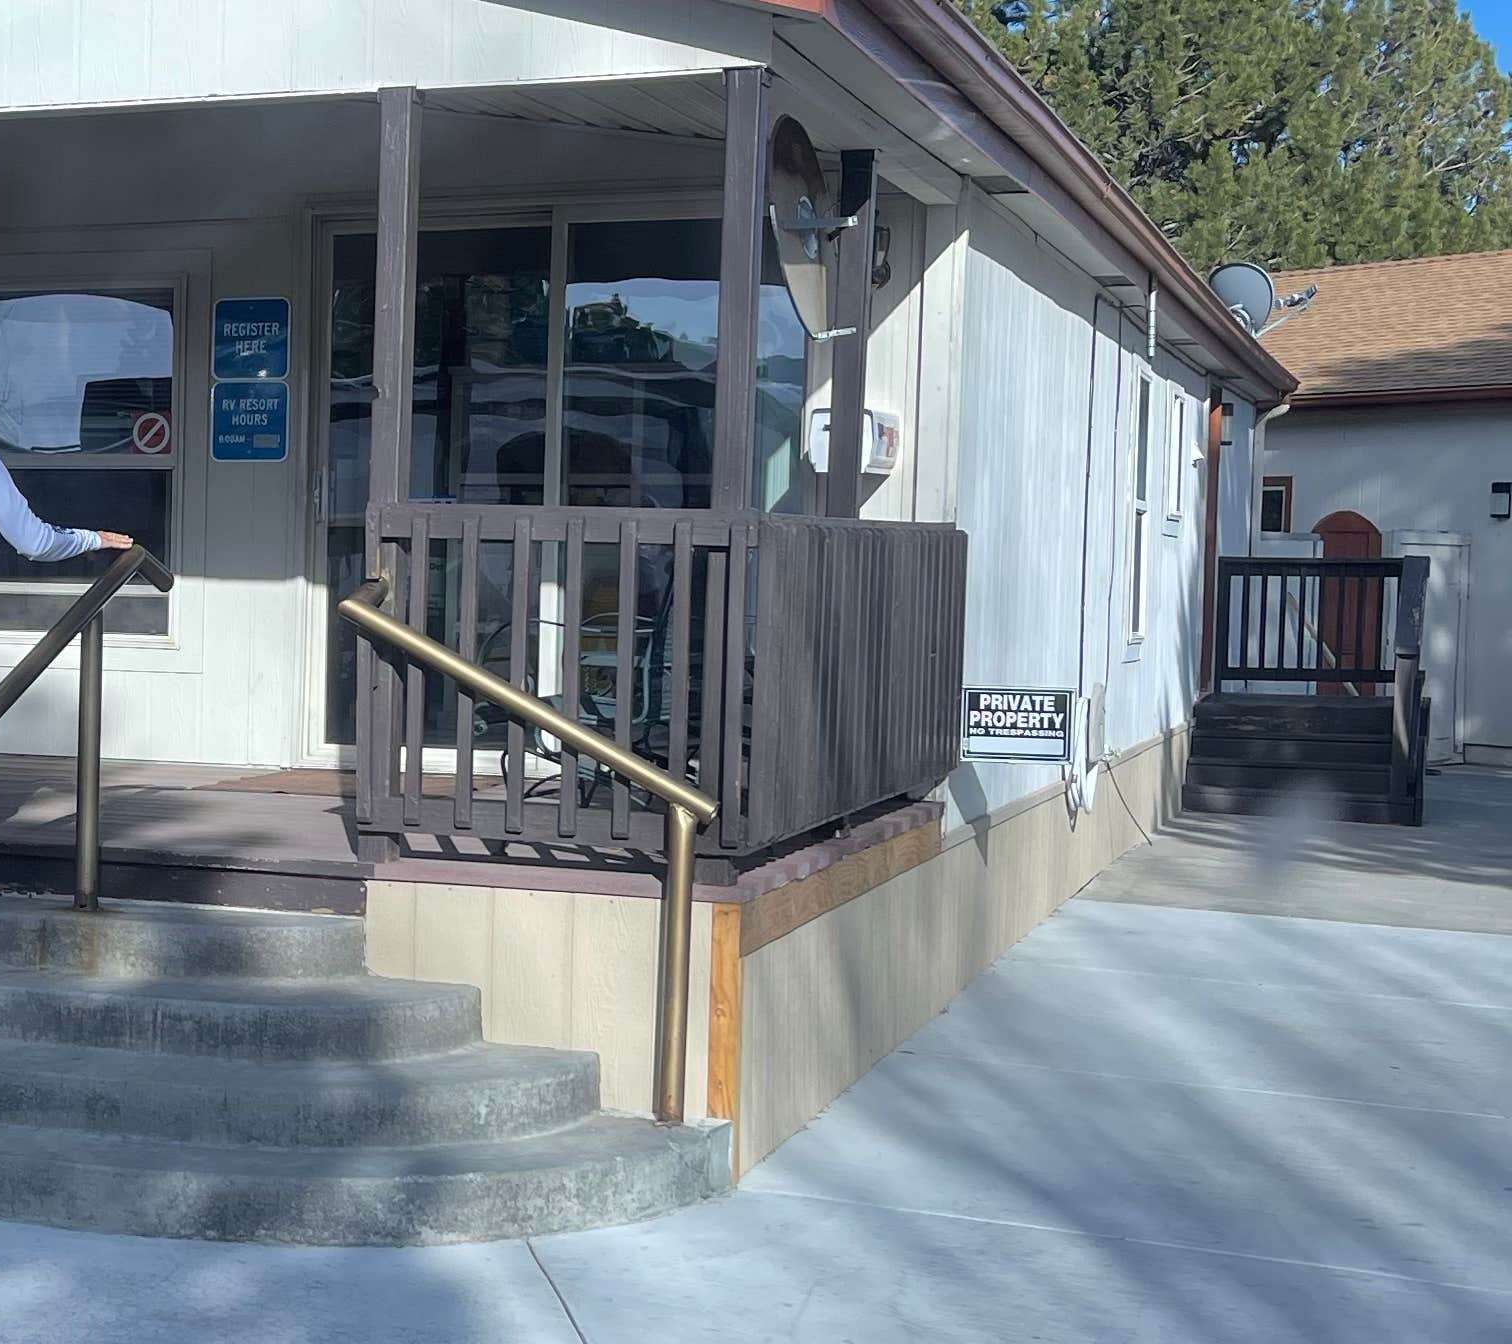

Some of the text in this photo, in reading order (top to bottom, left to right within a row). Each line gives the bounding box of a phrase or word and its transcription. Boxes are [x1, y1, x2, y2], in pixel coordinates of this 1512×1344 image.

[223, 322, 280, 337] REGISTER
[235, 340, 267, 354] HERE
[221, 398, 279, 411] RV RESORT
[231, 413, 269, 426] HOURS
[979, 694, 1055, 711] PRIVATE
[969, 711, 1064, 728] PROPERTY
[988, 728, 1064, 737] TRESPASSING
